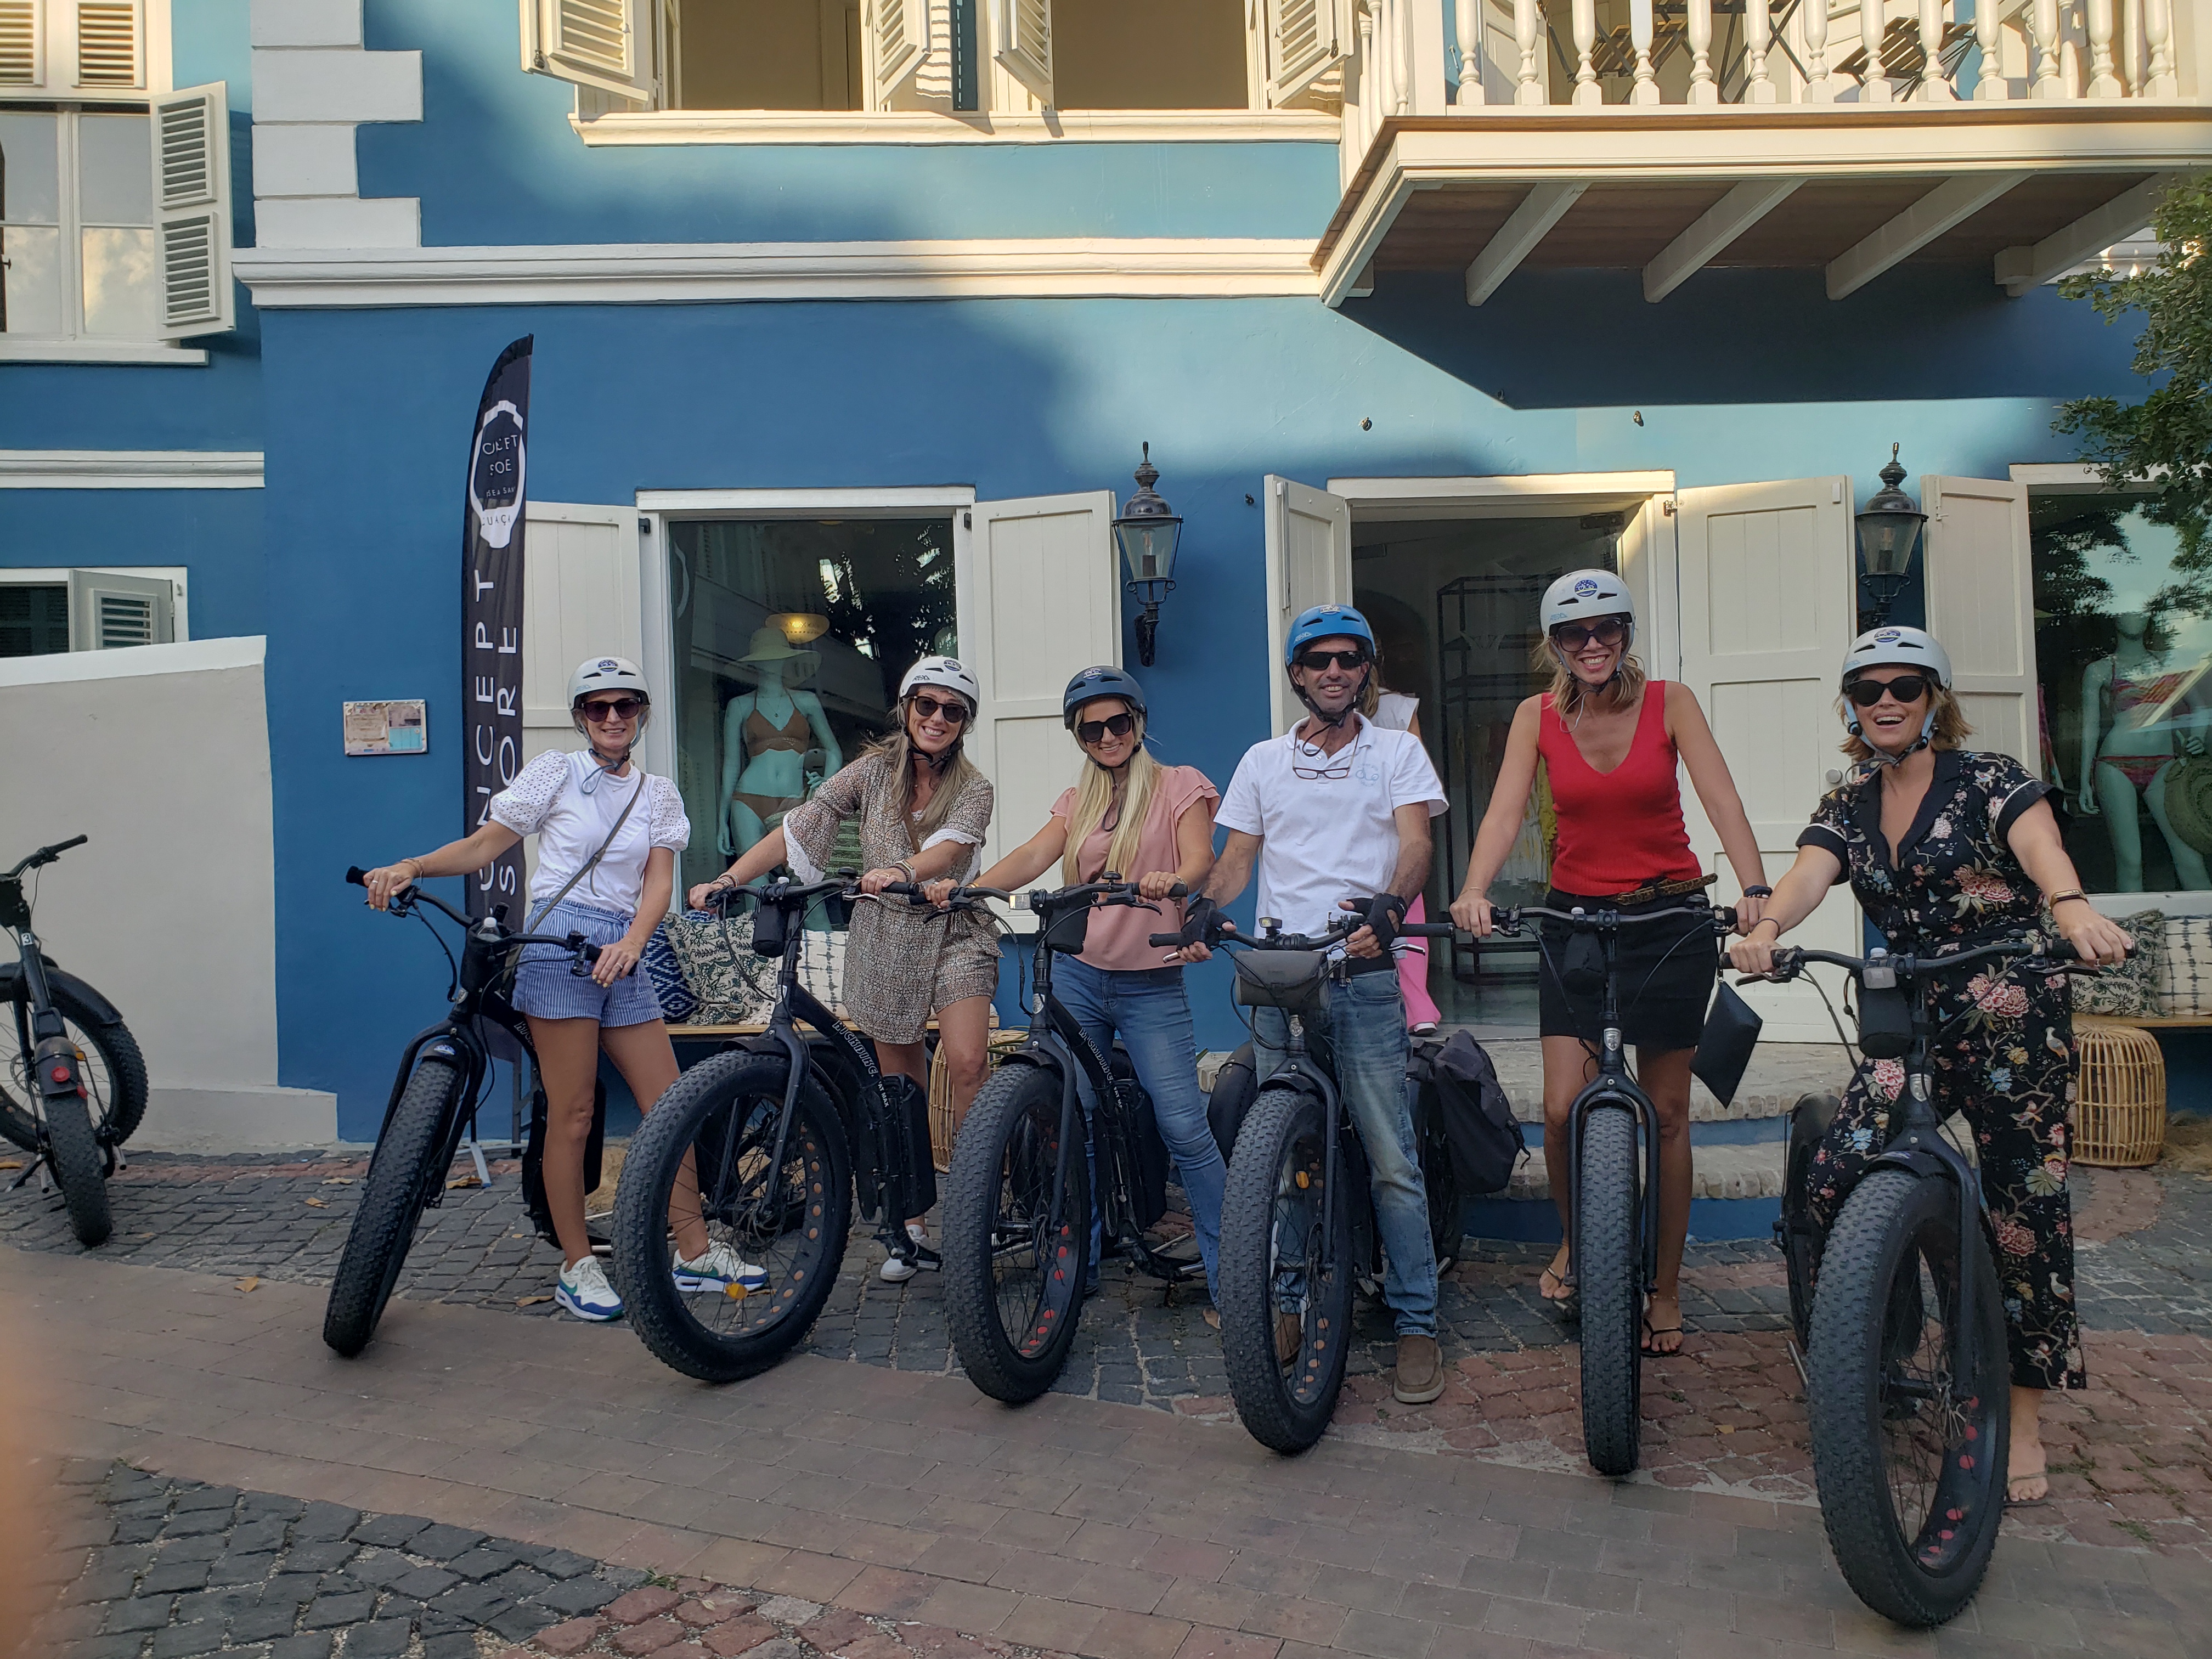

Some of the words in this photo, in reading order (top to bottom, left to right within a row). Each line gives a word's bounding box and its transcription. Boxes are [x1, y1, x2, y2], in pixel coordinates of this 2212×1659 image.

[497, 627, 517, 896] SORE
[23, 934, 31, 943] 3
[881, 1092, 890, 1108] MAX
